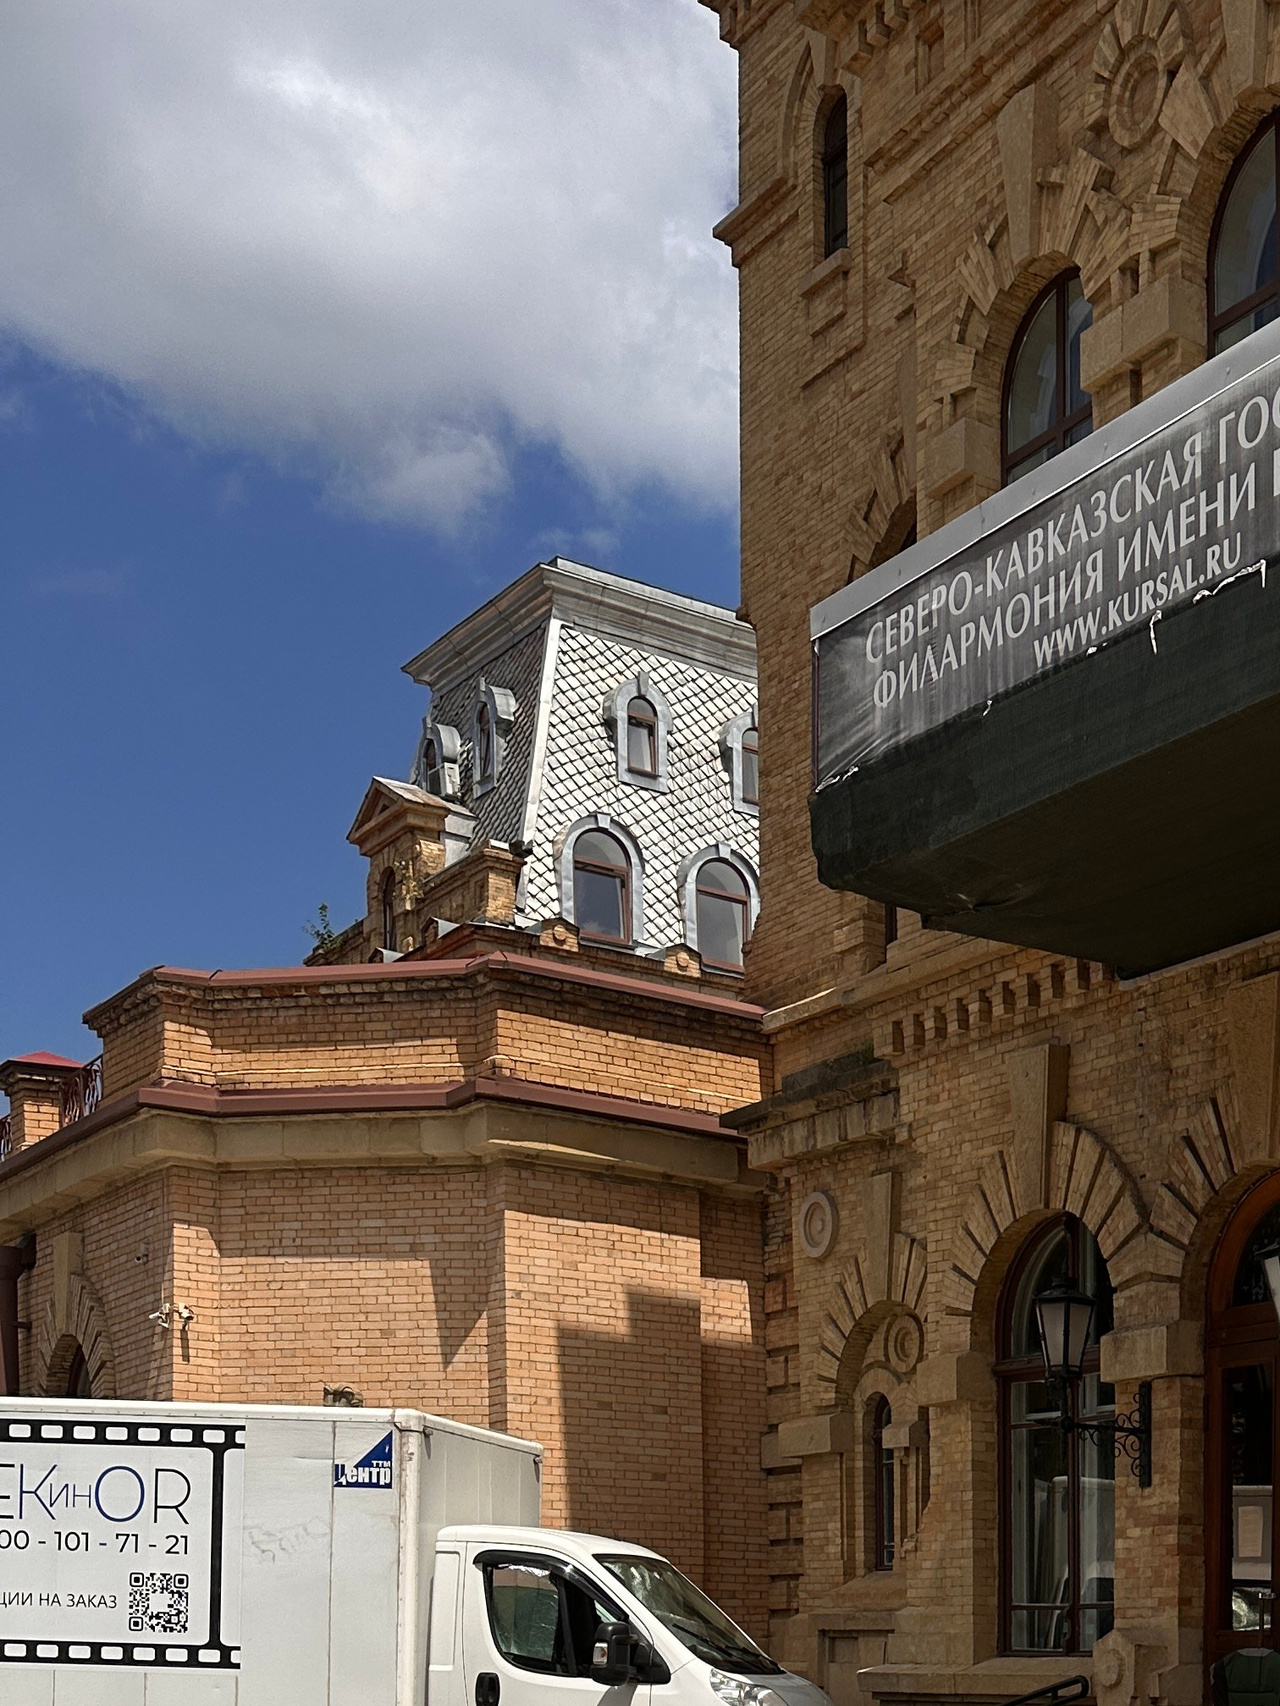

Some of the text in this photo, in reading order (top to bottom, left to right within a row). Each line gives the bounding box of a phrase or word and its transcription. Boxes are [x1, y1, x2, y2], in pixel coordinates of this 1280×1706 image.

[865, 431, 1202, 663] СЕВЕРО-КАВКАЗСКАЯ
[873, 549, 1103, 708] ФИЛАРМОНИЯ
[1118, 462, 1256, 582] ИМЕНИ
[1033, 533, 1242, 668] WWW.KURSAL.RU
[334, 1463, 391, 1486] Центр
[54, 1531, 90, 1552] 101
[115, 1533, 140, 1554] 71
[165, 1534, 189, 1555] 21
[39, 1593, 62, 1607] НА
[66, 1594, 118, 1609] ЗАКАЗ
